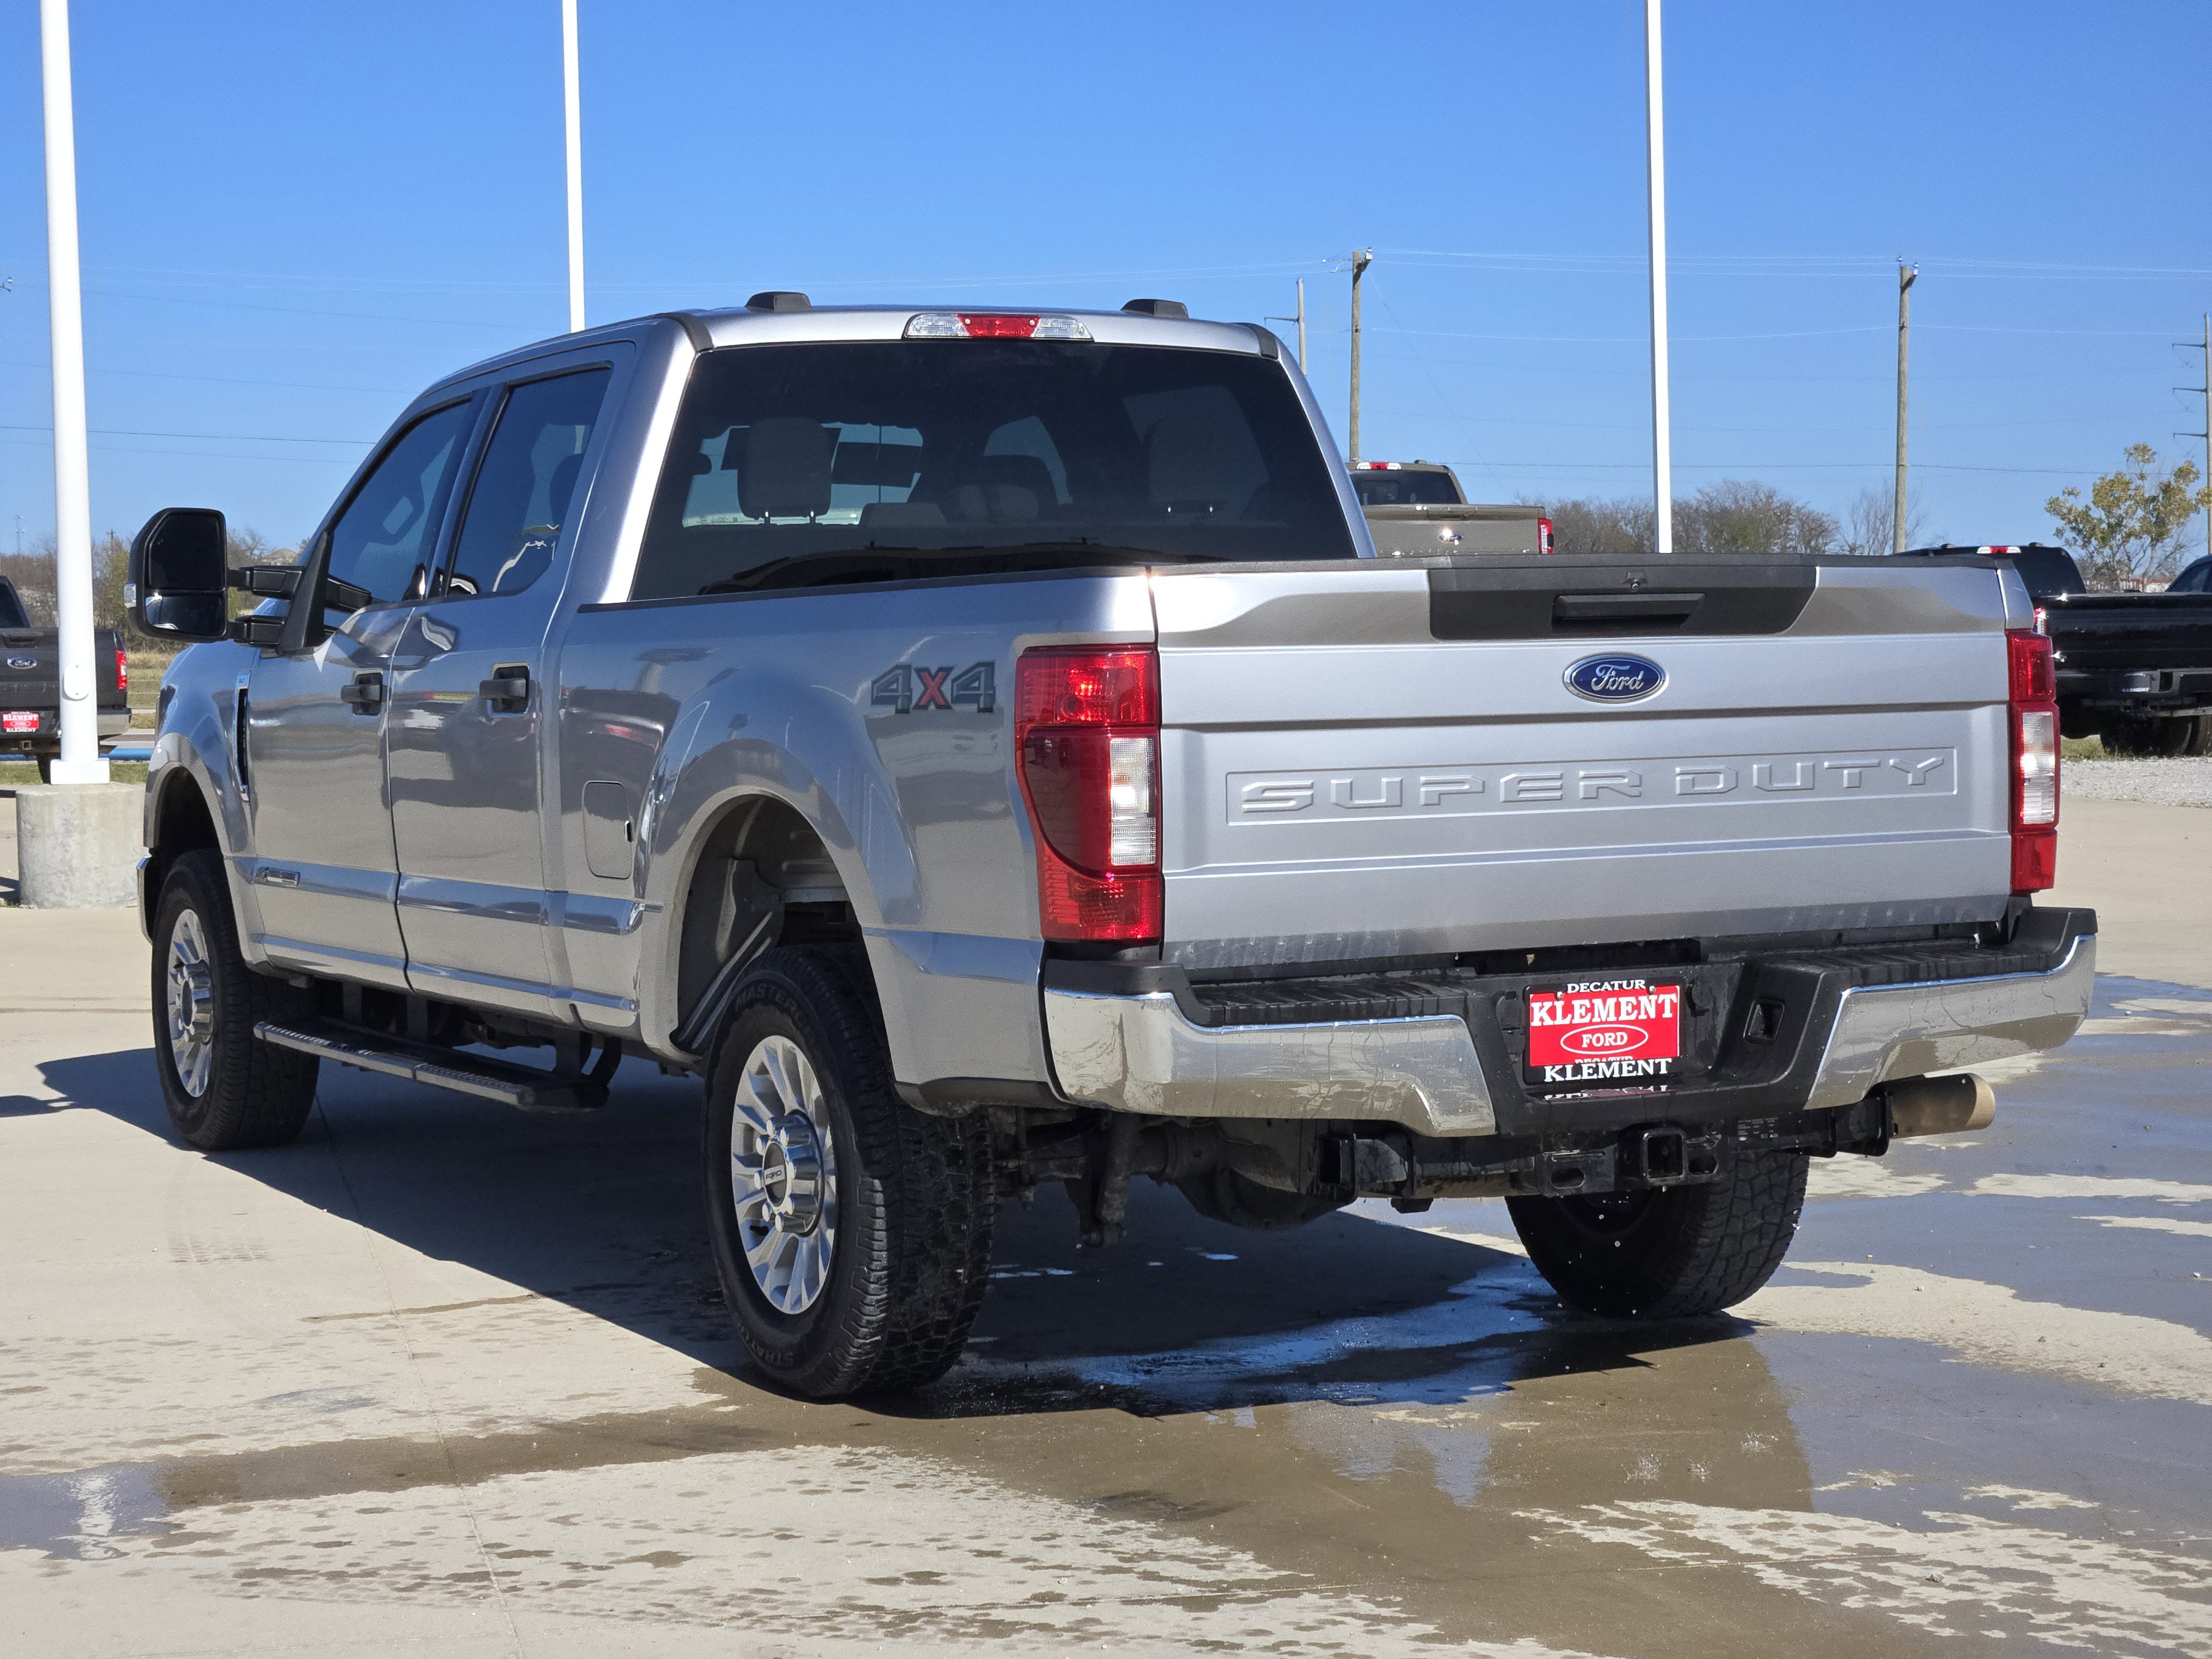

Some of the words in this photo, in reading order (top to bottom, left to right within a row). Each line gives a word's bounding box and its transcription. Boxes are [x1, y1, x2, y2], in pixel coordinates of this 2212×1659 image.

[1591, 664, 1645, 691] Ford
[1241, 768, 1642, 813] SUPER
[1675, 757, 1944, 796] DUTY
[1567, 979, 1646, 994] DECATUR
[1531, 994, 1678, 1027] KLEMENT
[1581, 1031, 1628, 1048] FORD
[1544, 1058, 1672, 1082] KLEMENT
